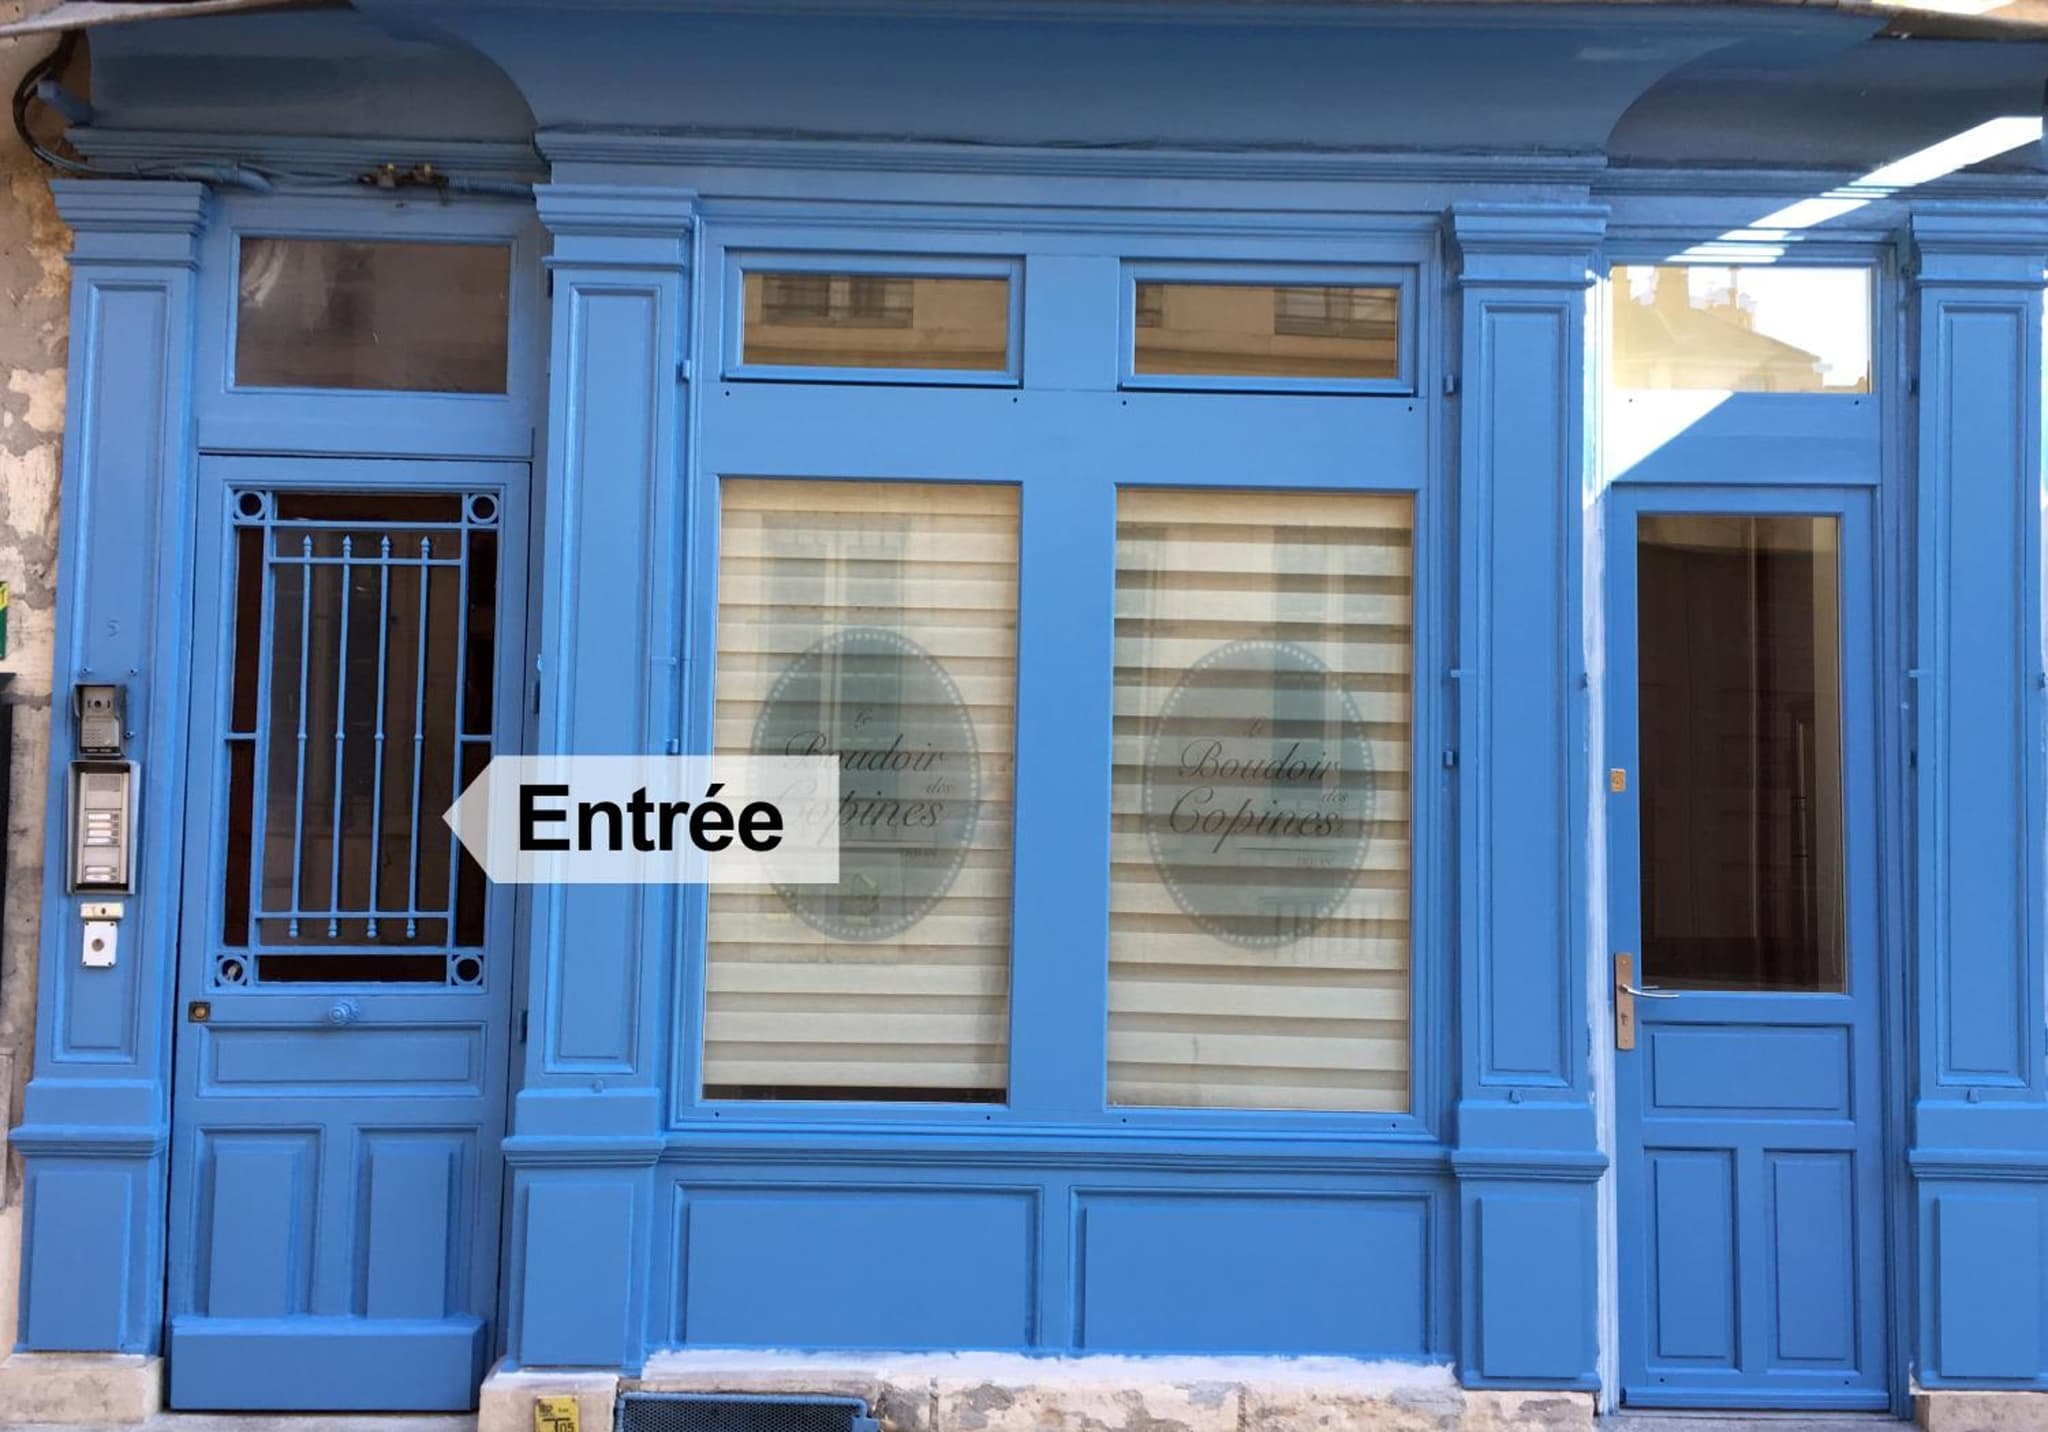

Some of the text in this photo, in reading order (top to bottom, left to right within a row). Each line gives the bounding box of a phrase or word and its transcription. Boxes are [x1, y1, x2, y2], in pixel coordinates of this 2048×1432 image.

[783, 730, 944, 773] Boudoir
[1177, 739, 1342, 782] Boudoir
[1168, 786, 1343, 854] Copines
